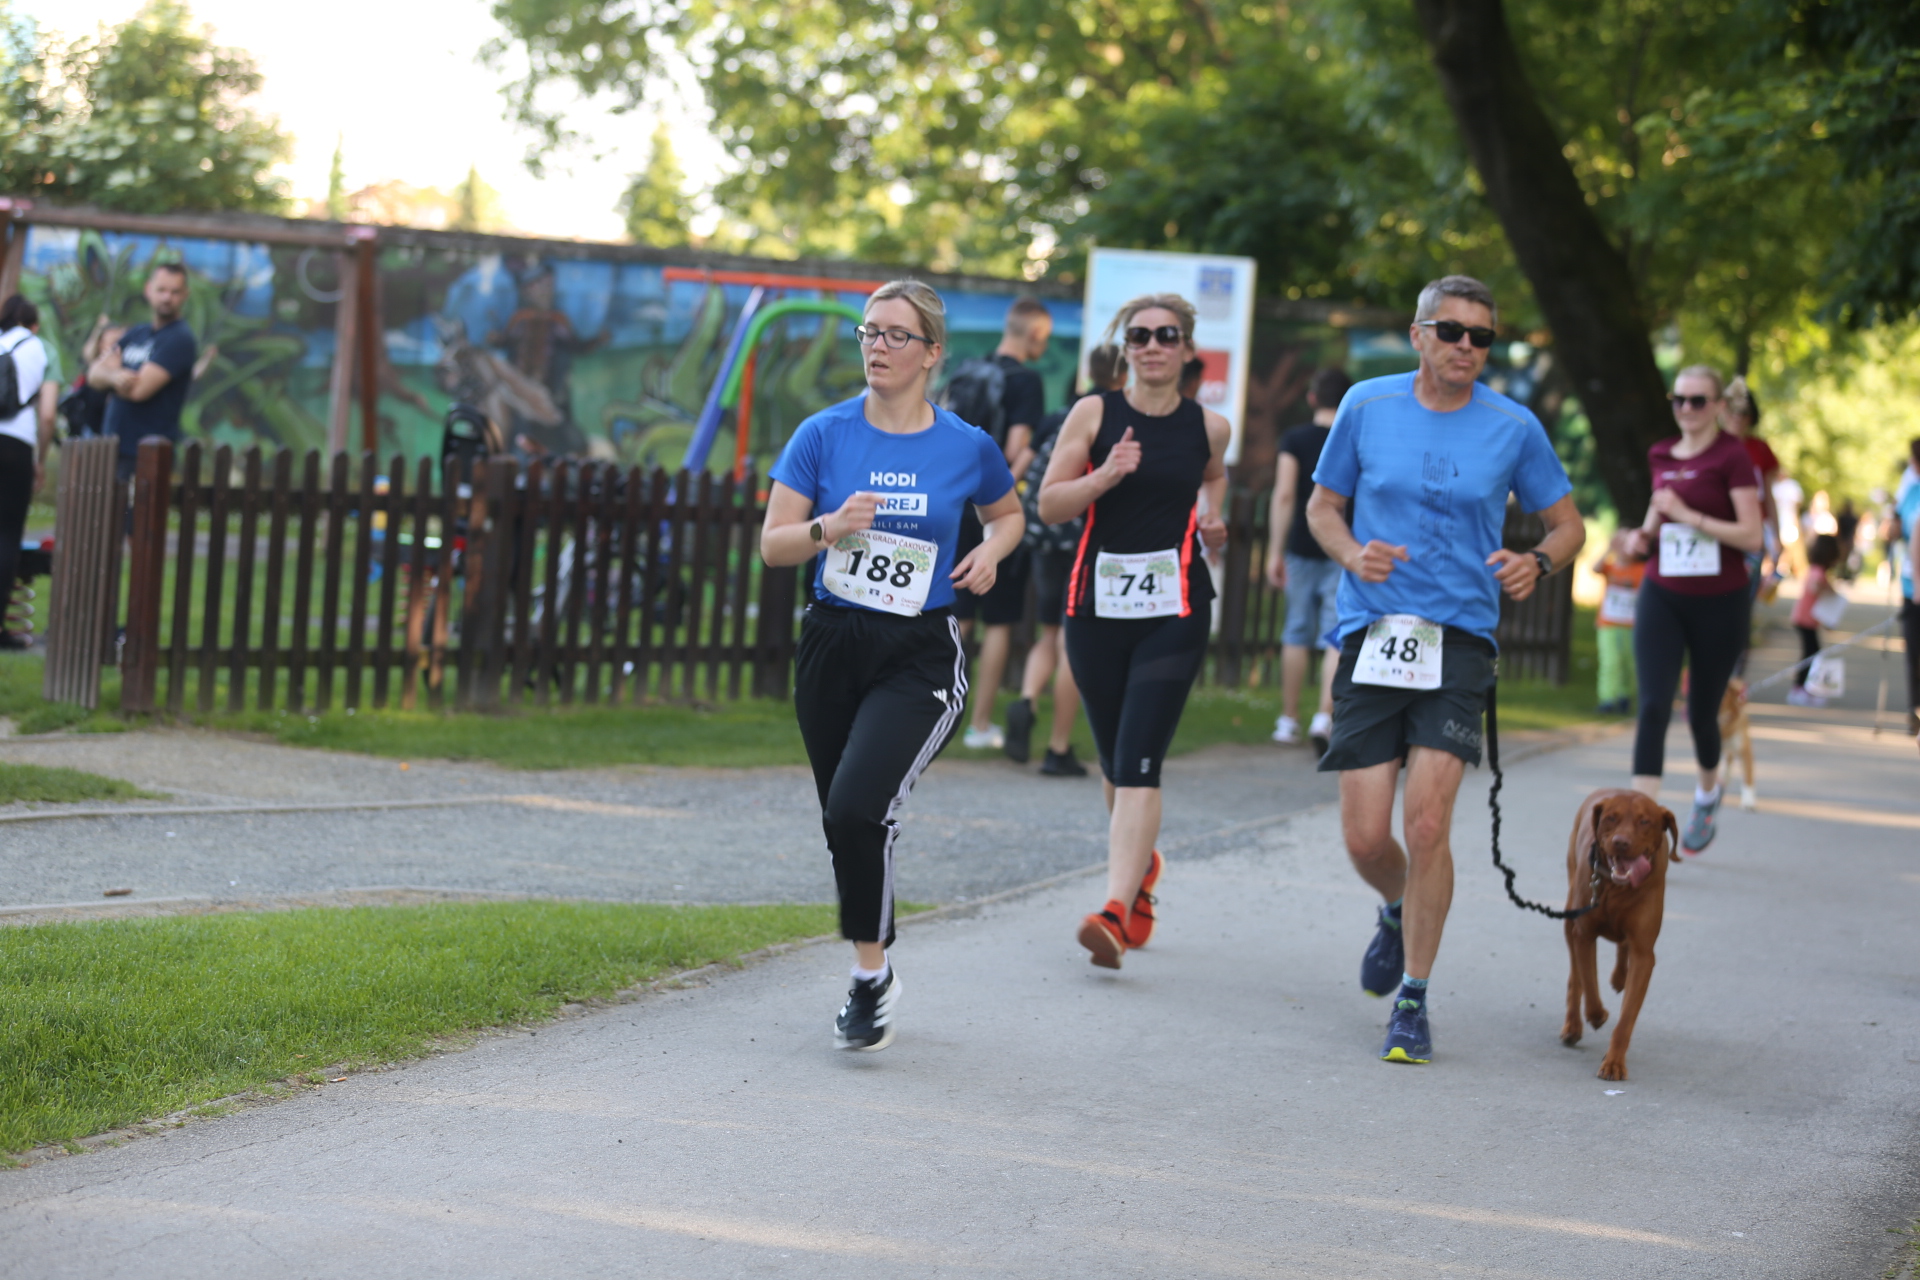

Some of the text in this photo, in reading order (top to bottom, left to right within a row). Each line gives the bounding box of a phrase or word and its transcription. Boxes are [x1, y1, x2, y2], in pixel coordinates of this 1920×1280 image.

[870, 471, 916, 487] HODI
[896, 522, 918, 530] SAM
[872, 533, 897, 546] GRADA
[848, 549, 915, 588] 188
[1120, 573, 1156, 596] 74
[1380, 635, 1419, 663] 48
